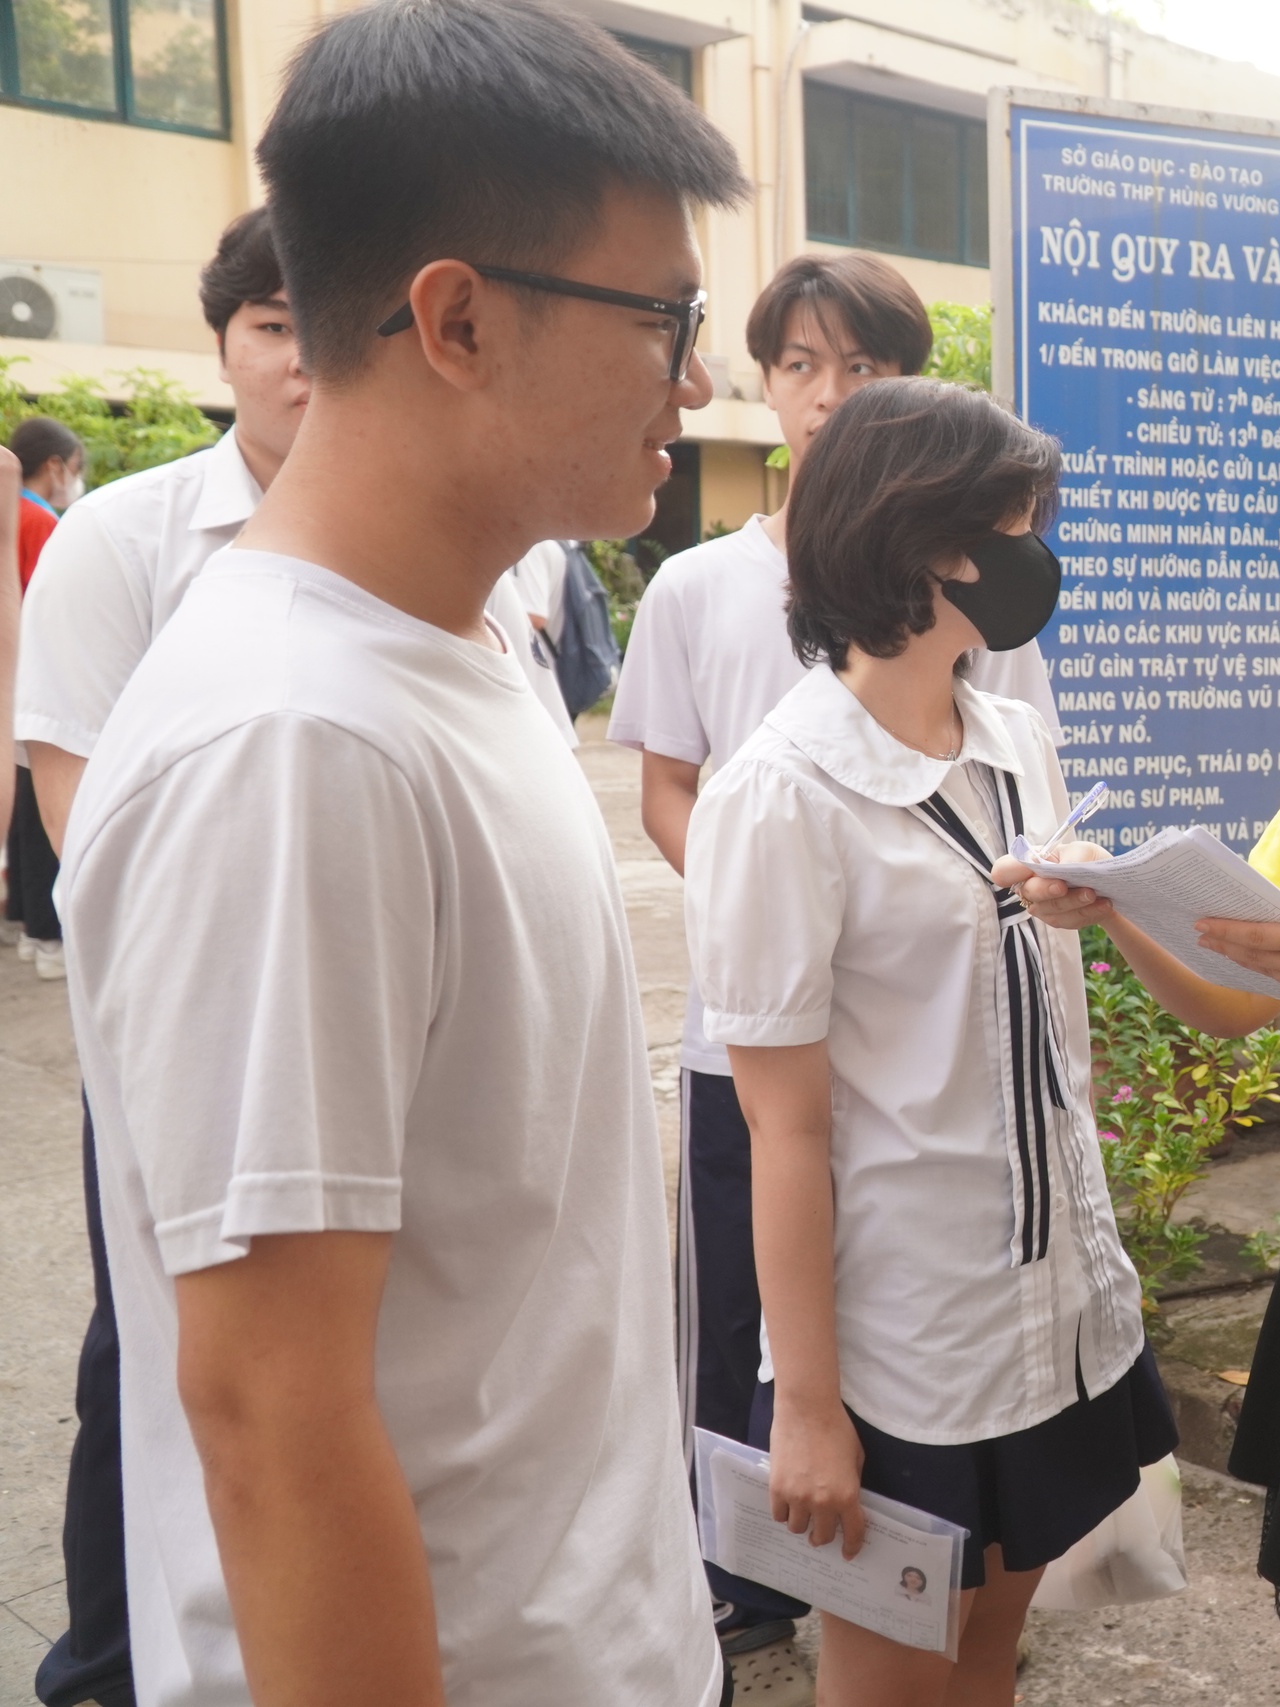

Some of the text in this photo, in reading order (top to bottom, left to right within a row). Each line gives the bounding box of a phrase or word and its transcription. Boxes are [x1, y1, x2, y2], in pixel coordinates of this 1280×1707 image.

[1061, 143, 1086, 166] SỞ
[1091, 150, 1135, 171] GIÁO
[1189, 160, 1225, 182] ĐÀO
[1229, 167, 1263, 187] TẠO
[1042, 171, 1279, 215] TRƯỜNG THPT HÙNG VƯƠNG
[1040, 217, 1100, 277] NỘI
[1111, 233, 1180, 282] QUY
[1188, 240, 1235, 281] RA
[1038, 298, 1103, 326] KHÁCH
[1107, 300, 1145, 330] ĐẾN
[1150, 307, 1222, 335] TRƯỜNG
[1227, 313, 1266, 339] LIÊN
[1039, 343, 1055, 366] 1/
[1058, 337, 1097, 367] ĐẾN
[1101, 347, 1163, 371] TRONG
[1167, 348, 1199, 373] GIỜ
[1203, 350, 1239, 376] LÀM
[1137, 384, 1186, 410] SÁNG
[1190, 387, 1215, 413] TỪ
[1228, 387, 1248, 414] 7h
[1137, 416, 1191, 445] CHIỀU
[1196, 421, 1224, 447] TỪ:
[1229, 421, 1257, 447] 13h
[1060, 445, 1107, 475] XUẤT
[1112, 450, 1167, 477] TRÌNH
[1171, 455, 1219, 484] HOẶC
[1223, 453, 1253, 480] GỬI
[1058, 480, 1112, 509] THIẾT
[1117, 489, 1148, 510] KHI
[1153, 487, 1201, 517] ĐƯỢC
[1205, 488, 1239, 513] YÊU
[1243, 486, 1278, 514] CẦU
[1058, 516, 1122, 543] CHỨNG
[1127, 523, 1172, 545] MINH
[1177, 521, 1226, 546] NHÂN
[1058, 556, 1108, 577] THEO
[1112, 553, 1138, 583] SỰ
[1140, 553, 1202, 578] HƯỚNG
[1206, 550, 1241, 579] DẪN
[1245, 552, 1280, 579] CỦA
[1059, 582, 1097, 610] ĐẾN
[1102, 587, 1133, 611] NƠI
[1138, 586, 1162, 611] VÀ
[1167, 587, 1221, 611] NGƯỜI
[1225, 584, 1261, 611] CẦN
[1059, 624, 1078, 644] ĐI
[1083, 619, 1120, 644] VÀO
[1124, 619, 1161, 645] CÁC
[1165, 625, 1202, 644] KHU
[1206, 621, 1241, 650] VỰC
[1059, 652, 1095, 678] GIỮ
[1100, 652, 1133, 678] GÌN
[1139, 653, 1188, 682] TRẬT
[1193, 654, 1219, 682] TỰ
[1223, 653, 1247, 682] VỆ
[1058, 690, 1116, 711] MANG
[1121, 686, 1161, 711] VÀO
[1166, 685, 1242, 709] TRƯỜNG
[1247, 684, 1272, 708] VŨ
[1061, 714, 1152, 744] CHÁY NỔ.
[1060, 756, 1128, 778] TRANG
[1134, 755, 1192, 780] PHỤC,
[1197, 748, 1242, 773] THÁI
[1247, 748, 1272, 776] ĐỘ
[1140, 785, 1166, 808] SƯ
[1169, 786, 1224, 811] PHẠM.
[1226, 816, 1249, 841] VÀ
